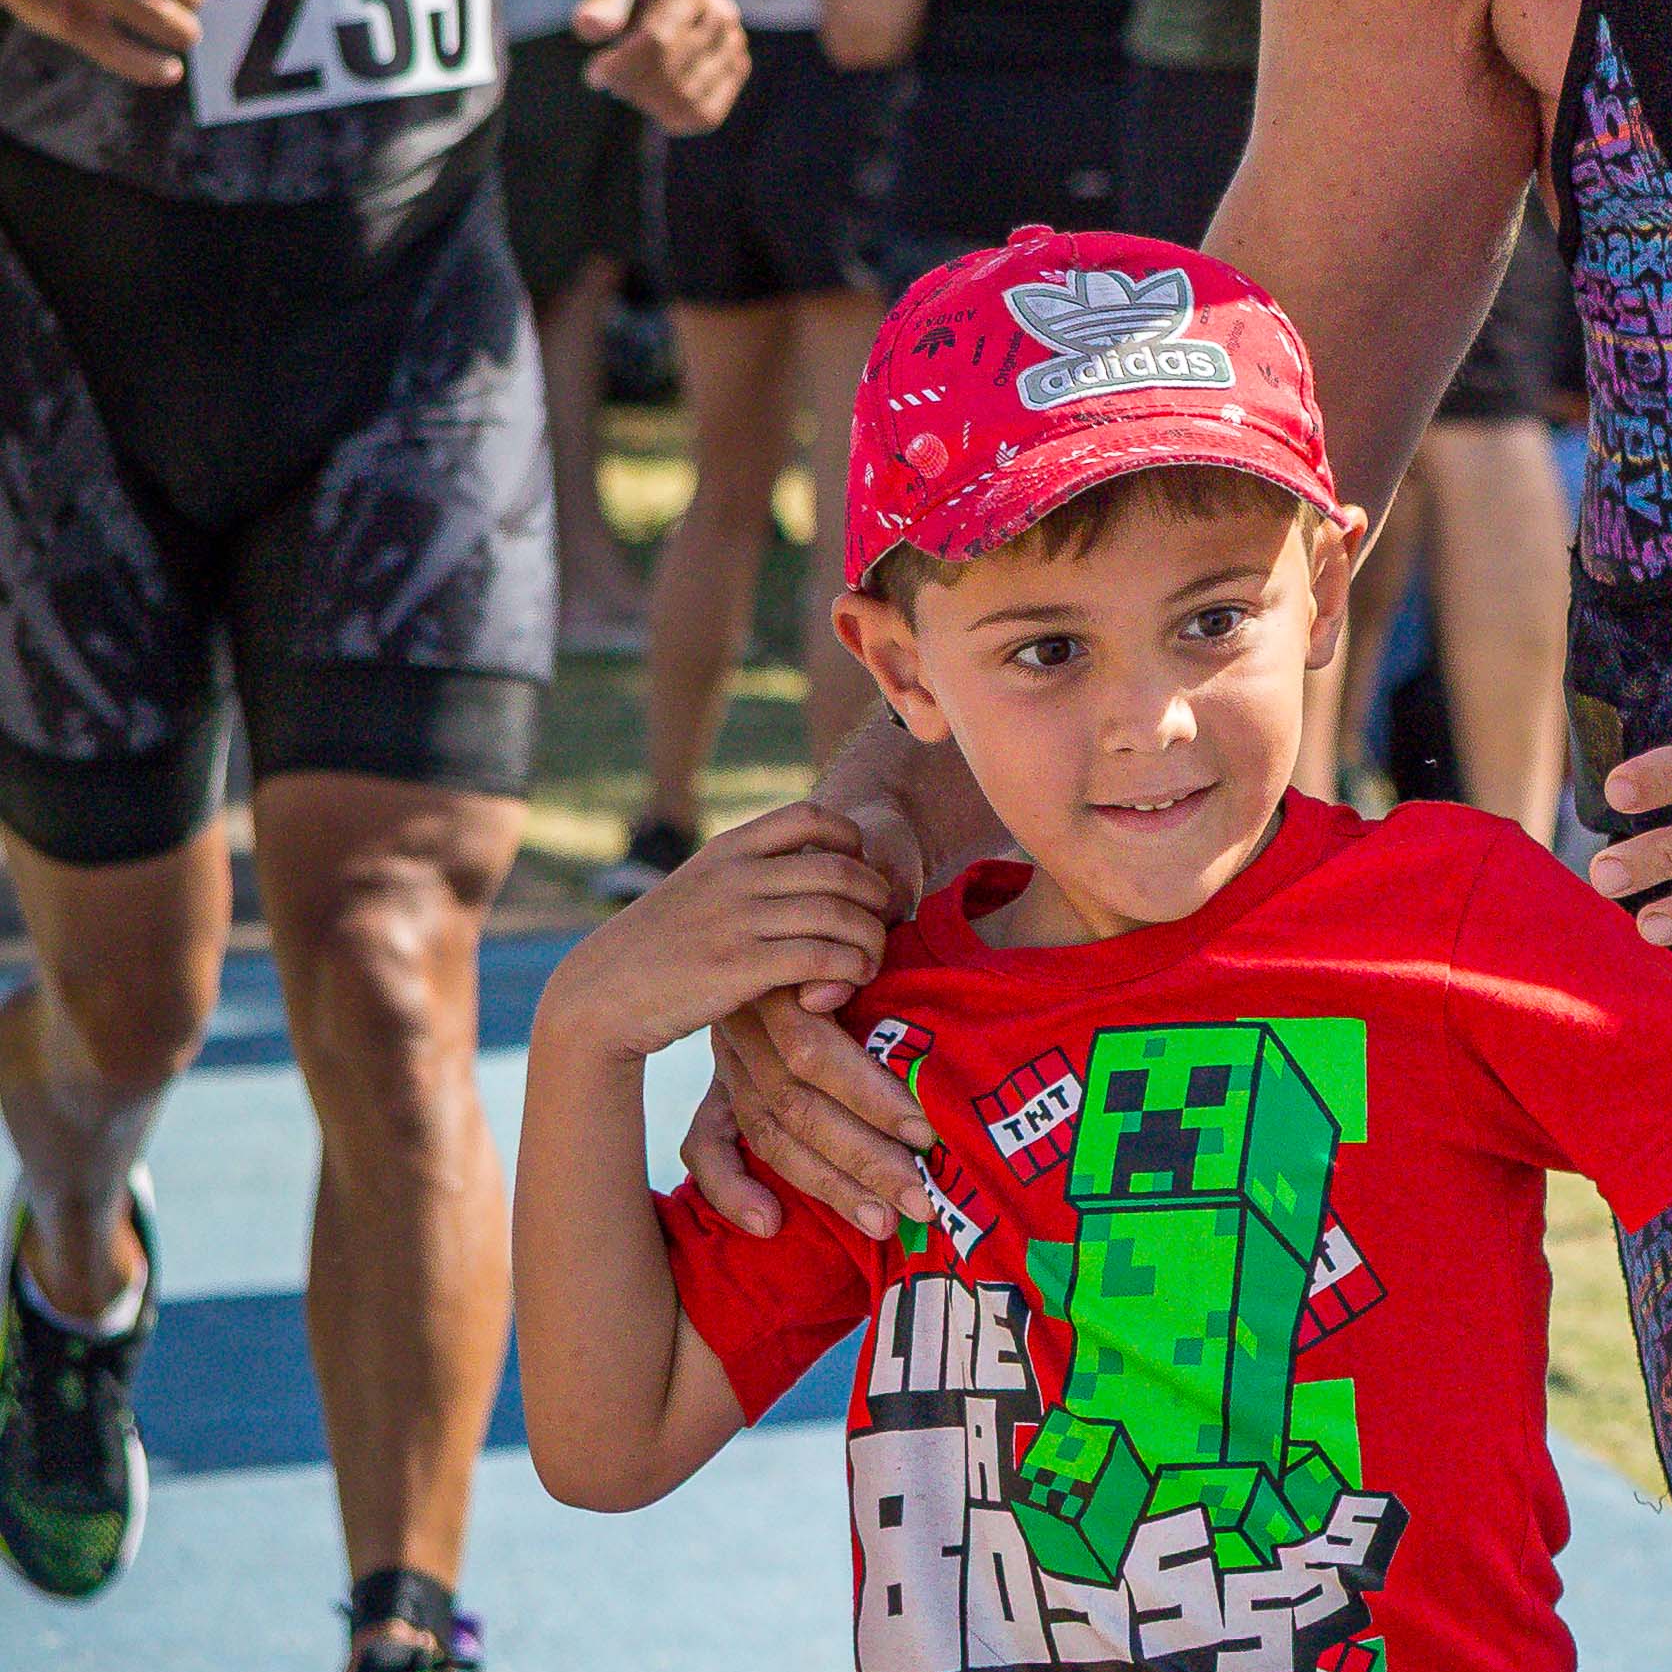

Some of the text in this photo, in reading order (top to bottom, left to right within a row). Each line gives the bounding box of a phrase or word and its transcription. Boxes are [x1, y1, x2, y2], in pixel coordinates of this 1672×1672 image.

[1040, 345, 1217, 396] adidas
[1003, 1084, 1070, 1143] TNT
[867, 1272, 1027, 1398] LIKE
[964, 1396, 1002, 1504] A
